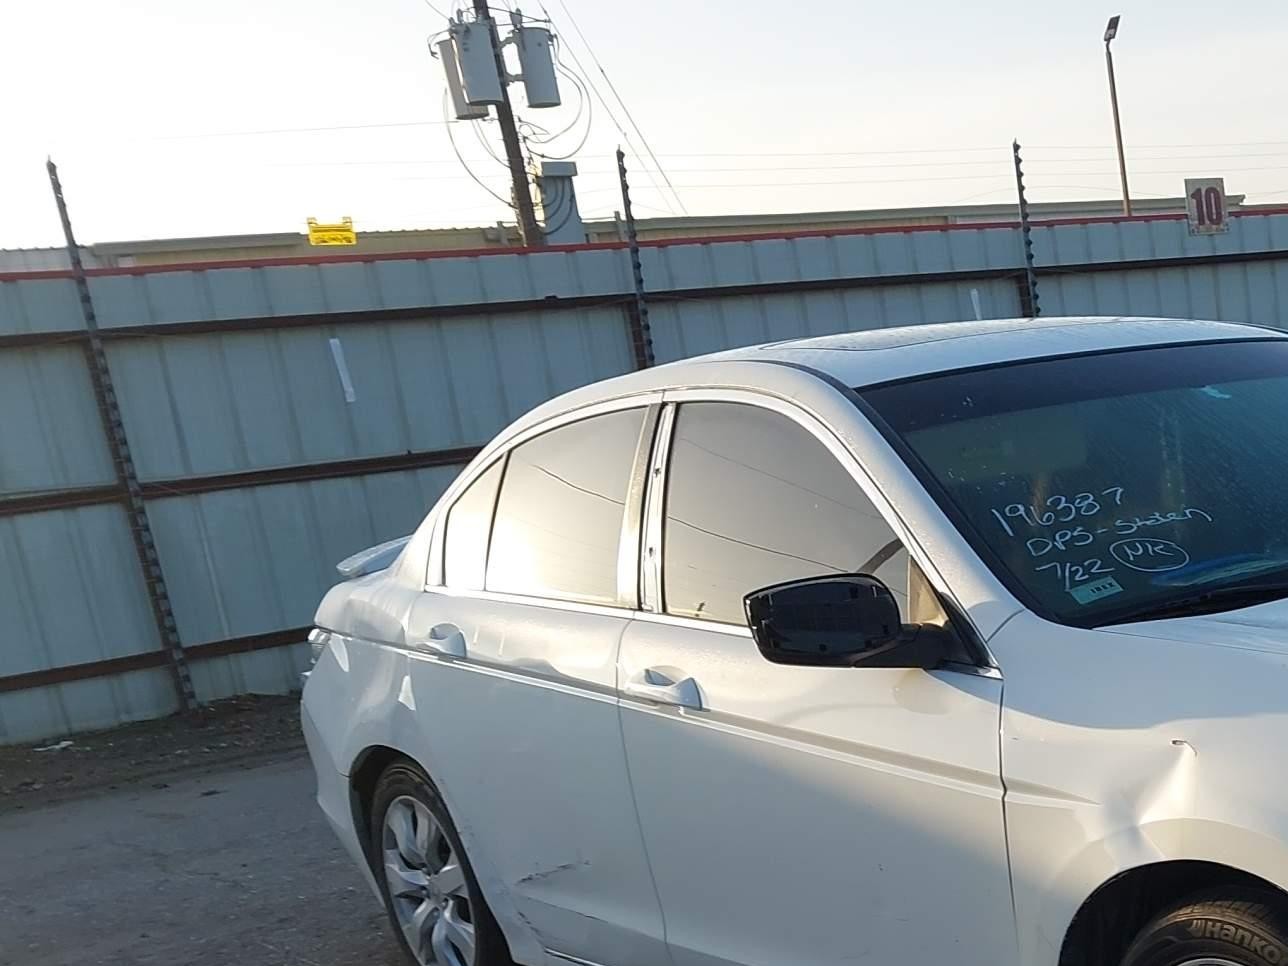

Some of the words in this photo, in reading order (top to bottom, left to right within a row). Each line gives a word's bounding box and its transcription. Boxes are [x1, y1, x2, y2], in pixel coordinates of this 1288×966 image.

[1191, 187, 1222, 225] 10
[992, 487, 1124, 536] 196387
[1035, 559, 1115, 592] 7/22
